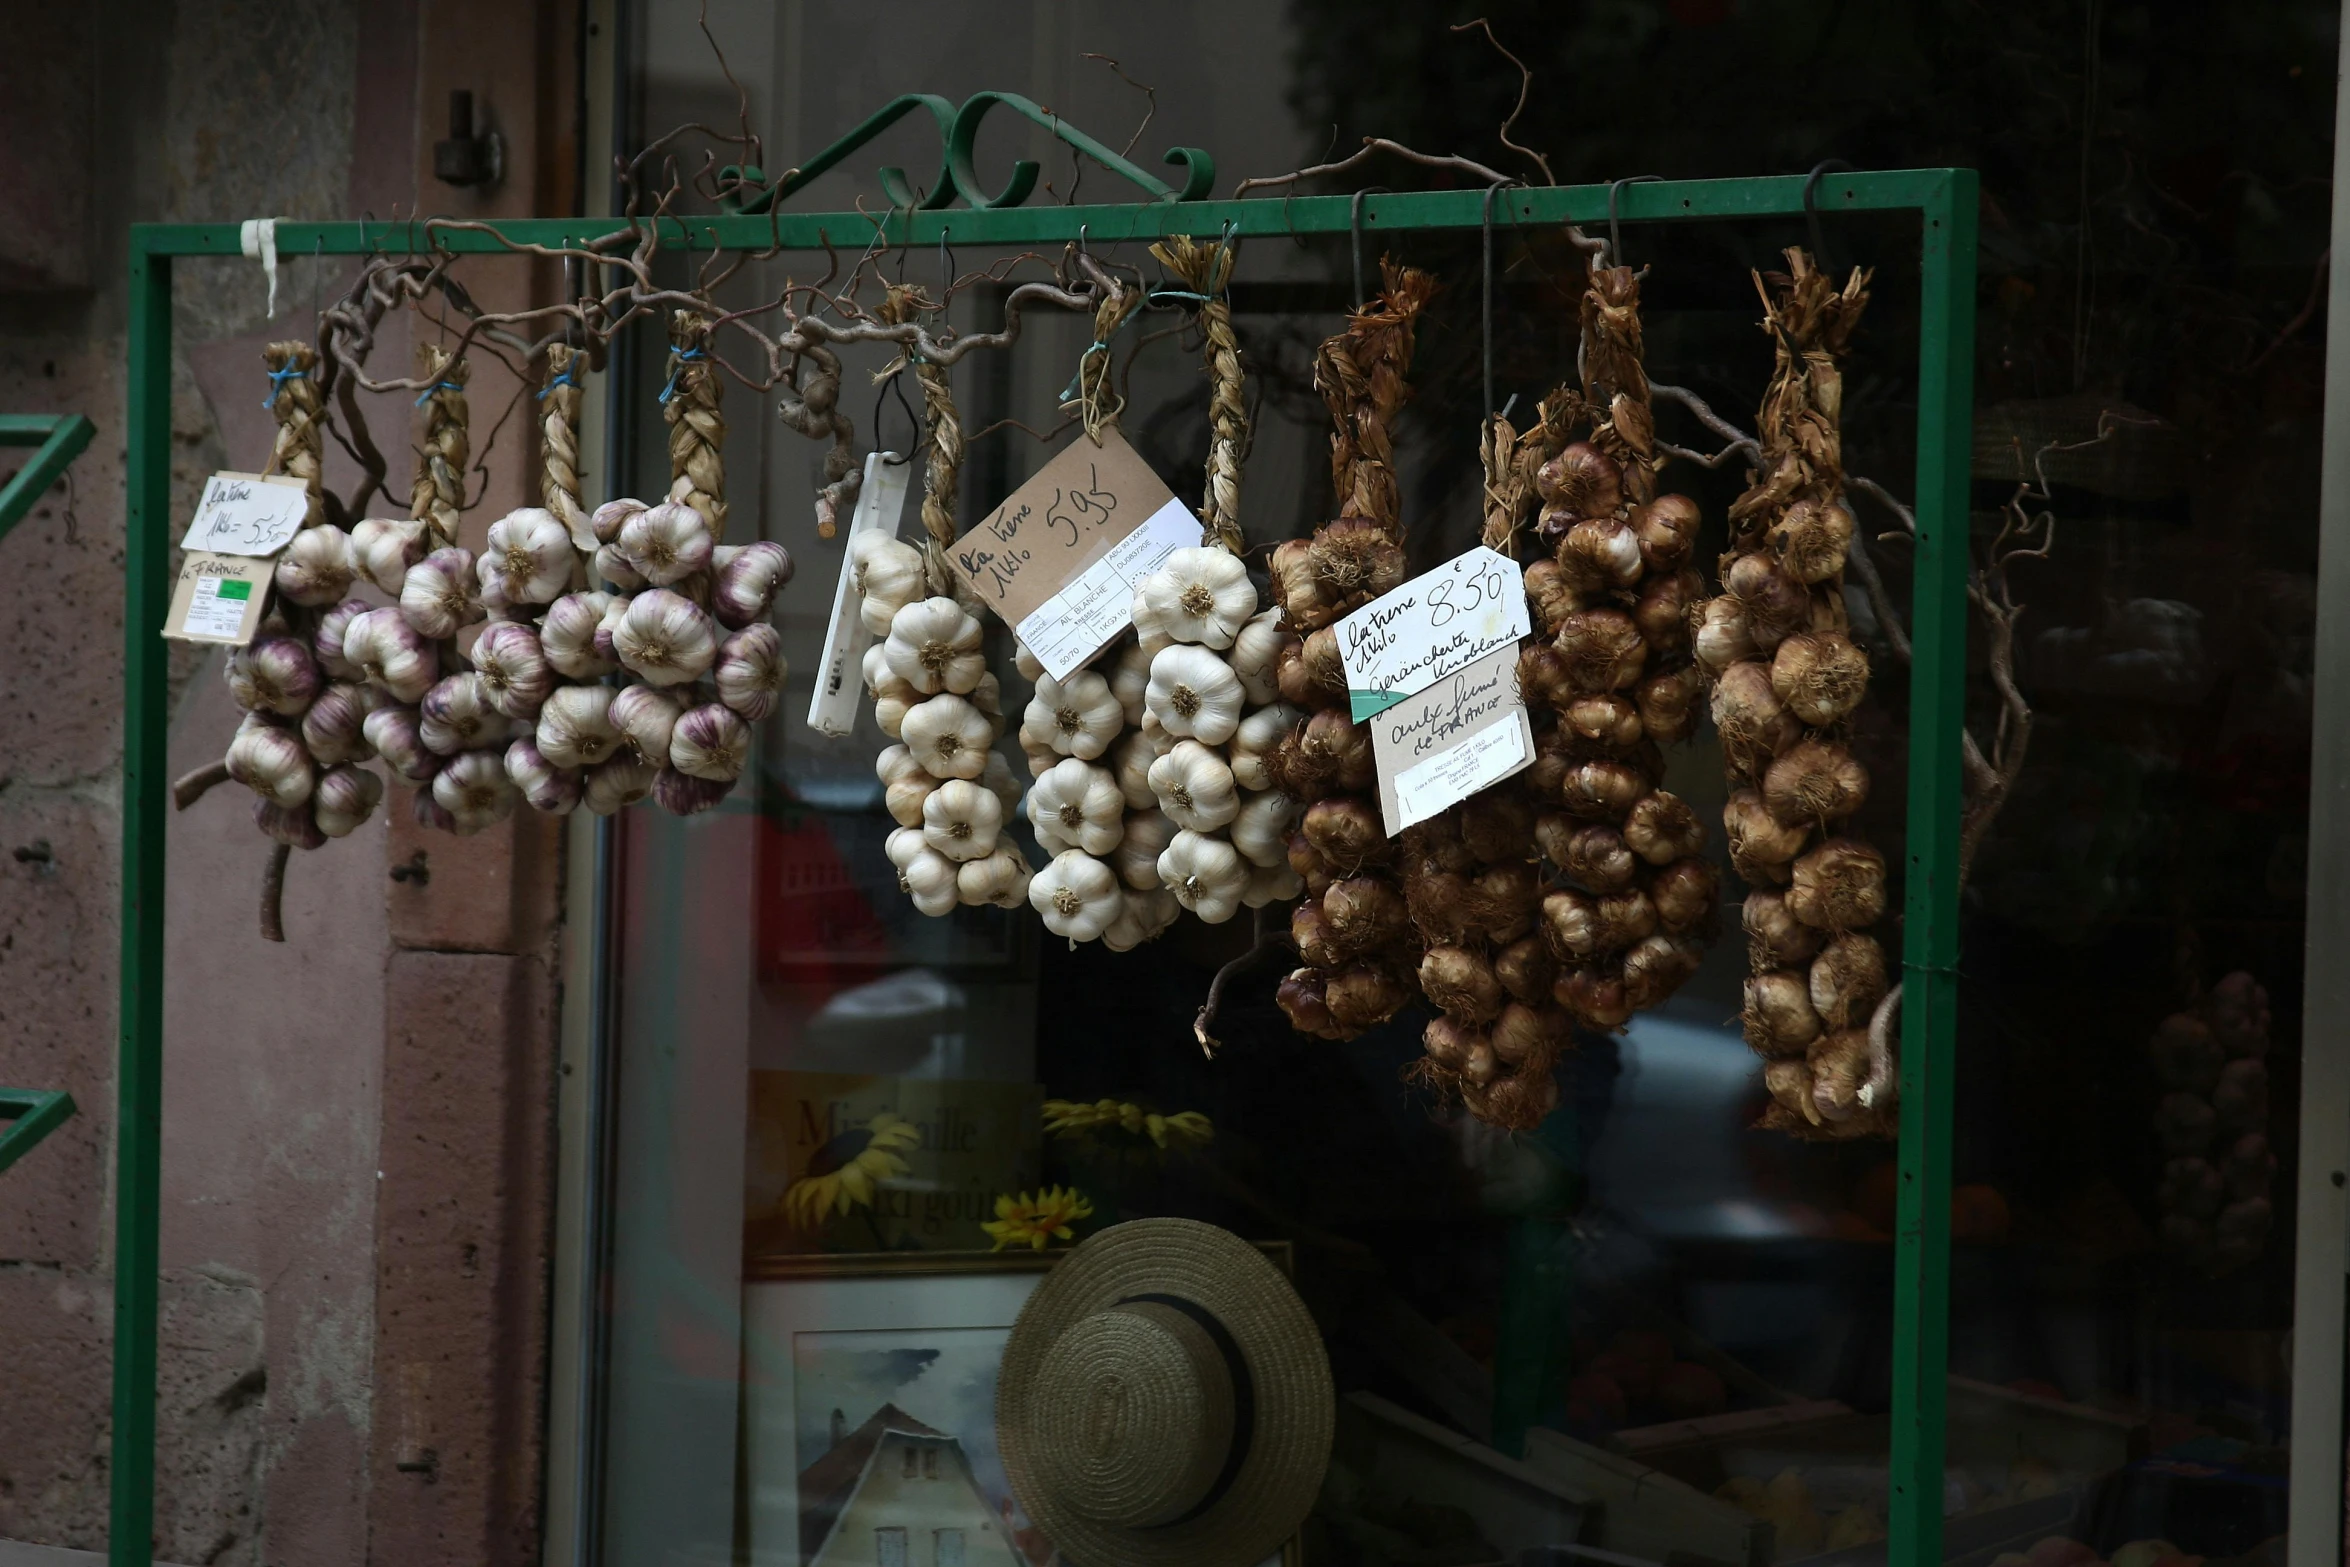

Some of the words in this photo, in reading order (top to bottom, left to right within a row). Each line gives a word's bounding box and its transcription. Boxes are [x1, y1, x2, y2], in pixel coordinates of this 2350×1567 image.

[1046, 462, 1117, 547] 5.95
[1107, 546, 1121, 560] ABC
[192, 560, 248, 577] FRANCE
[1059, 614, 1072, 626] AIL
[1073, 584, 1108, 614] BLANCHE
[1059, 647, 1080, 665] 50/70
[903, 1100, 977, 1154] aille
